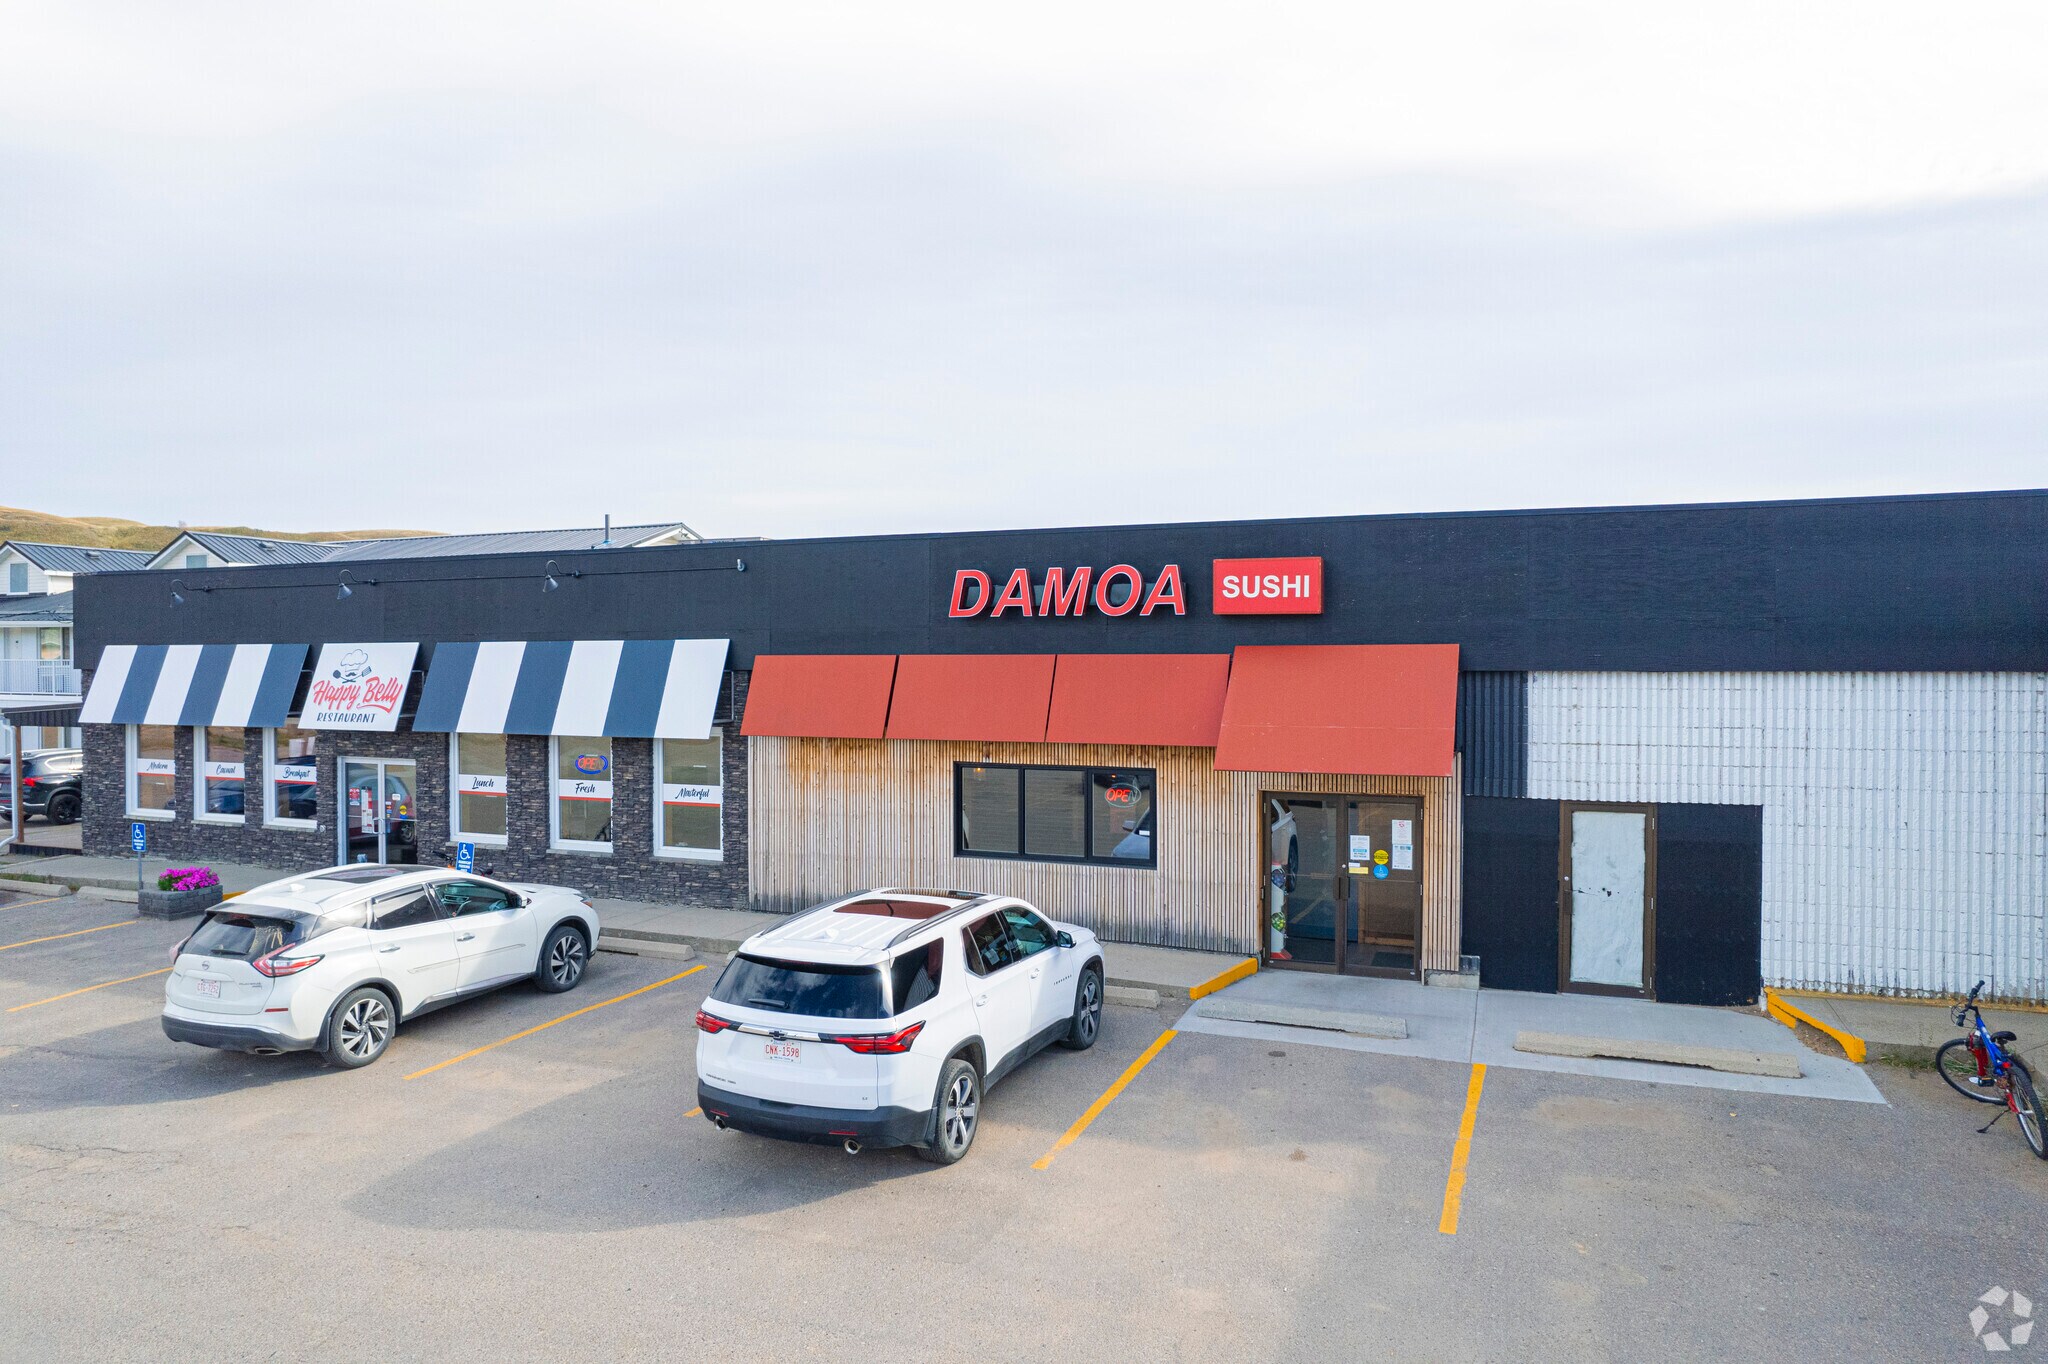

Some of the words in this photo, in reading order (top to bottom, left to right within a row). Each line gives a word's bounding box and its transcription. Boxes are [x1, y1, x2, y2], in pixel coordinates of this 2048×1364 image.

[948, 564, 1187, 618] DAMOA
[1222, 574, 1311, 599] SUSHI
[313, 680, 361, 710] Happy
[357, 676, 403, 713] Belly
[316, 712, 376, 723] RESTAURANT
[146, 762, 168, 771] Modern
[216, 764, 236, 775] Casual
[282, 766, 311, 779] Breakfast
[472, 776, 494, 789] Lunch
[575, 782, 595, 794] Fresh
[674, 787, 710, 801] Masterful
[1106, 788, 1138, 802] OPEN
[765, 1044, 800, 1058] CNK-1598
